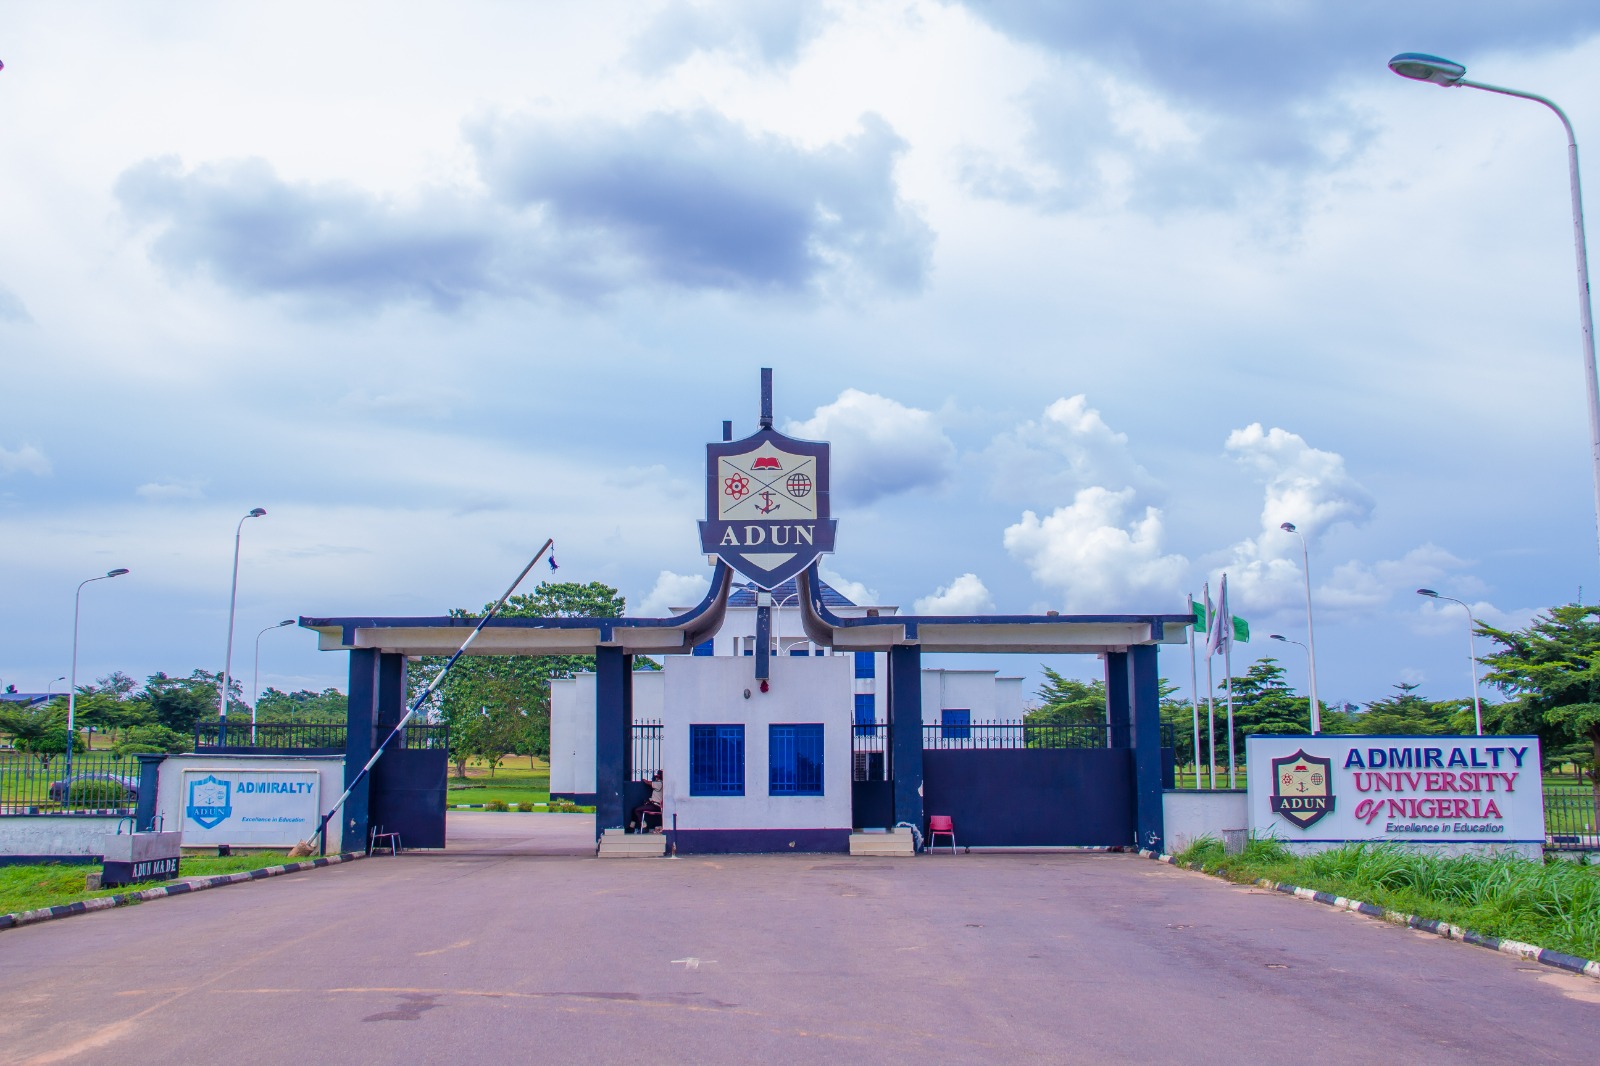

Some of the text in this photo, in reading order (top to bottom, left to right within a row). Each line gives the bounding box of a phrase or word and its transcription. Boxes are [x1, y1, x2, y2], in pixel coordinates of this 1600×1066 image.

[719, 525, 816, 546] ADUN
[1343, 746, 1529, 769] ADMIRALTY
[236, 781, 315, 794] ADMIRALTY
[1353, 772, 1519, 793] UNIVERSITY
[1280, 798, 1326, 809] ADUN
[1387, 798, 1503, 819] NIGERIA
[193, 807, 225, 817] ADUN
[1385, 822, 1504, 833] Excellence in Education
[132, 862, 152, 878] ADUN
